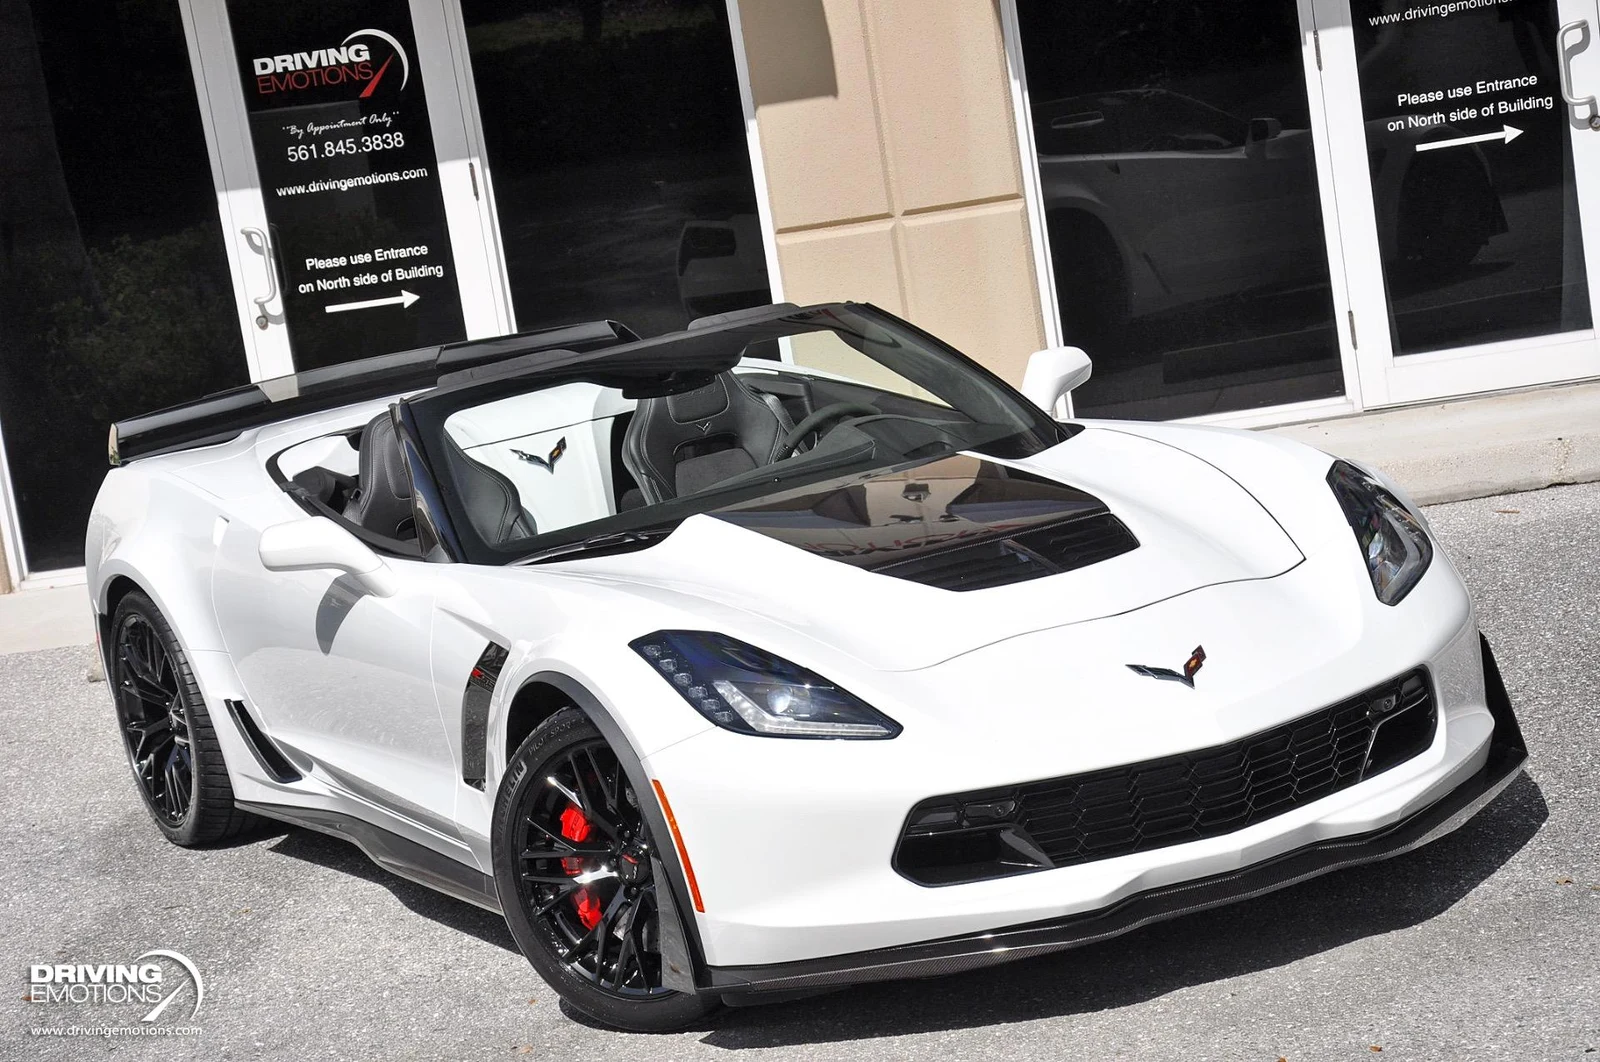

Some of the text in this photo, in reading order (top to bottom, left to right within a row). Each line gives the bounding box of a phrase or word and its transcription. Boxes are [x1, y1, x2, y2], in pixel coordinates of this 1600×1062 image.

[253, 44, 370, 75] DRIVING
[258, 63, 373, 93] EMOTIONS
[1398, 76, 1537, 106] Please use Entrance
[307, 117, 367, 135] Appointment
[1388, 97, 1553, 131] on North side of Building
[288, 132, 404, 161] 561.845.3838
[276, 168, 427, 196] www.drivingemotions.com
[306, 246, 428, 270] Please use Entrance
[299, 265, 443, 293] on North side of Building
